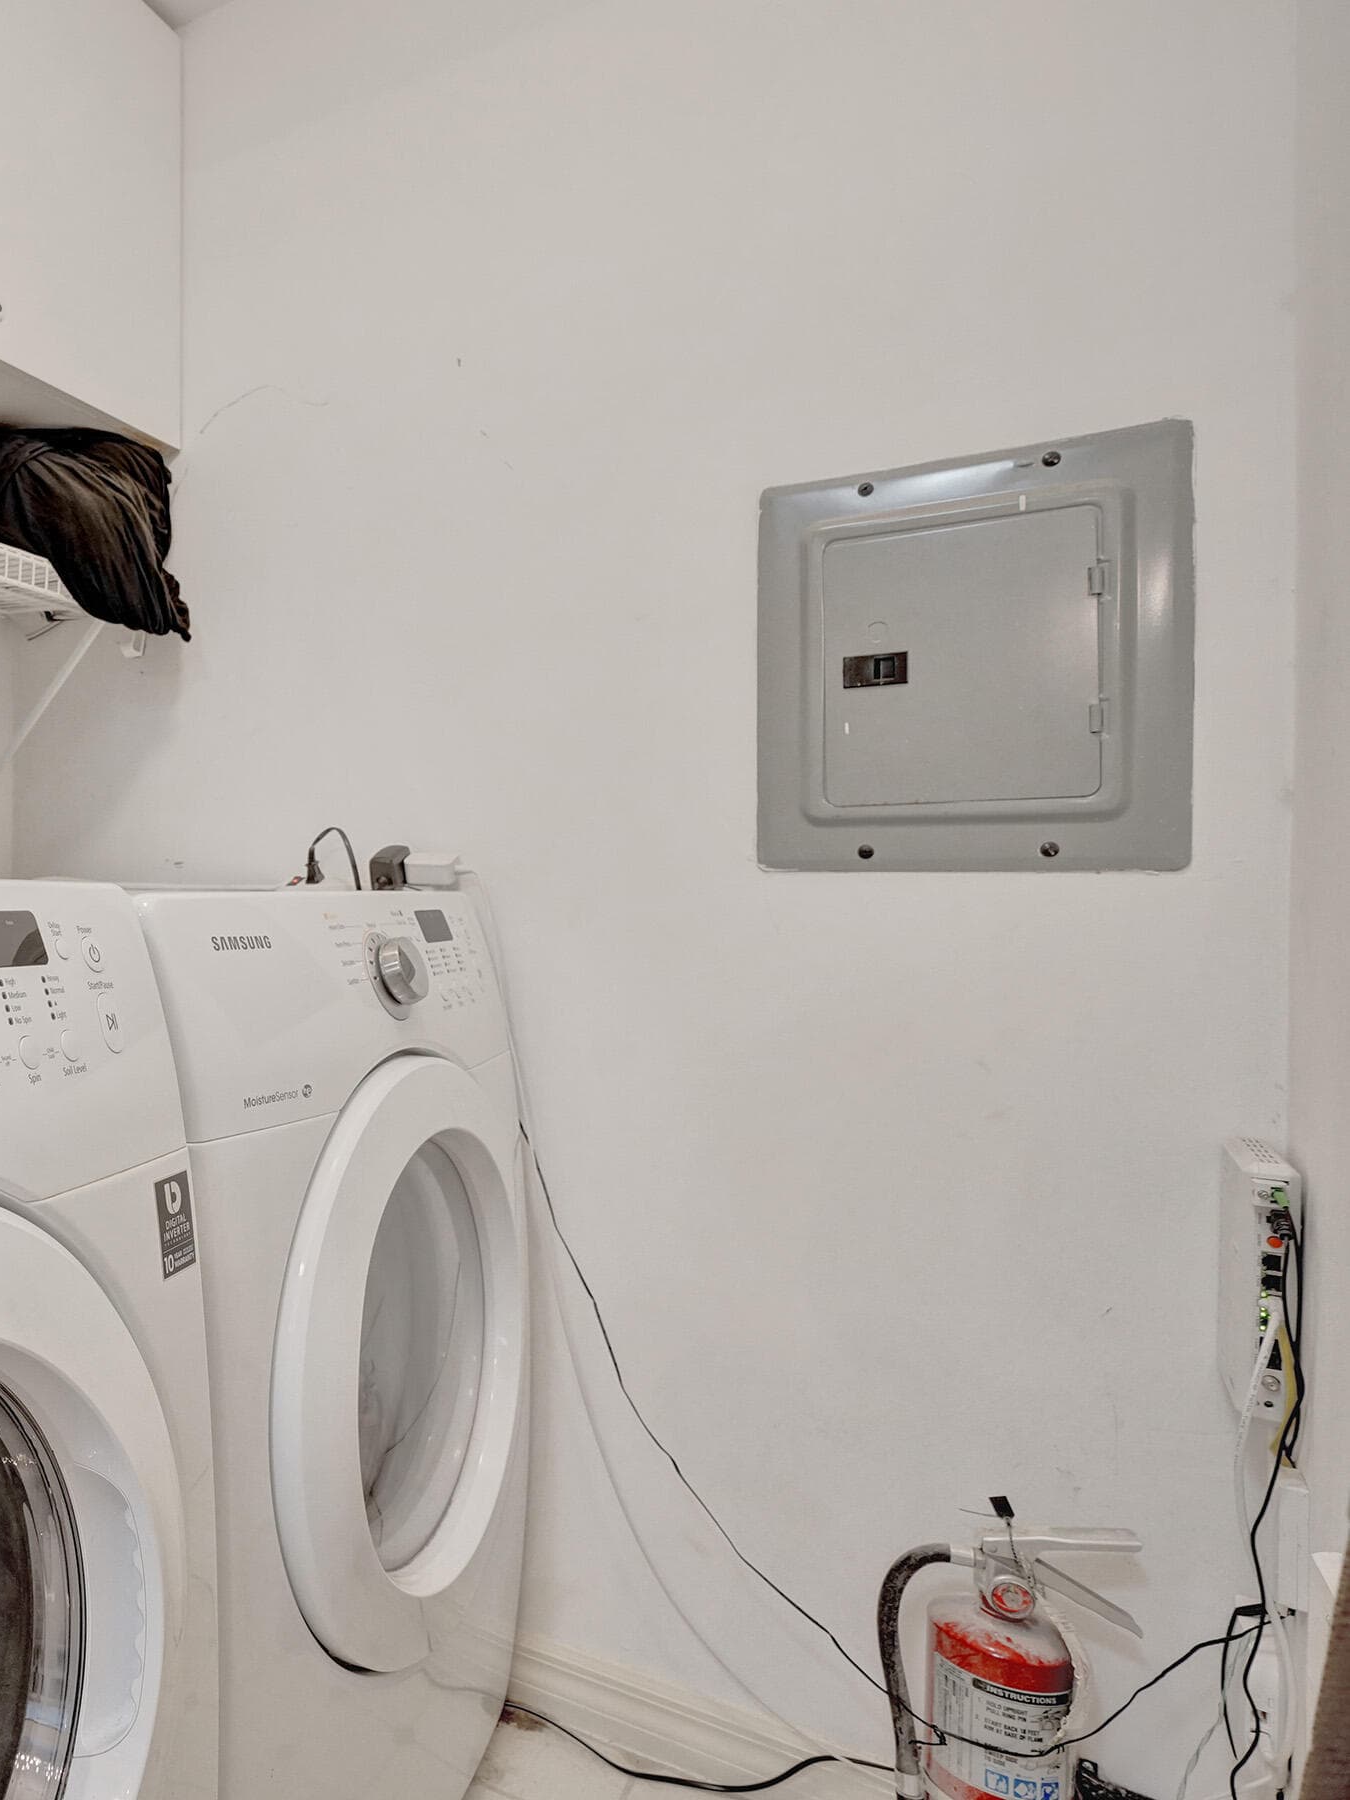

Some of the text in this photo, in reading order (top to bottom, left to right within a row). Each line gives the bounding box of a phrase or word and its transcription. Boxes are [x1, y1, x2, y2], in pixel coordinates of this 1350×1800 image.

[211, 935, 272, 951] SAMSUNG
[63, 1063, 87, 1077] Soil Level
[28, 1073, 42, 1086] Spin
[243, 1090, 298, 1109] MoistureSensor
[165, 1213, 186, 1230] DIGITAL
[163, 1221, 190, 1242] INVERTER
[164, 1254, 174, 1274] 10
[986, 1685, 1057, 1704] INSTRUCTIONS
